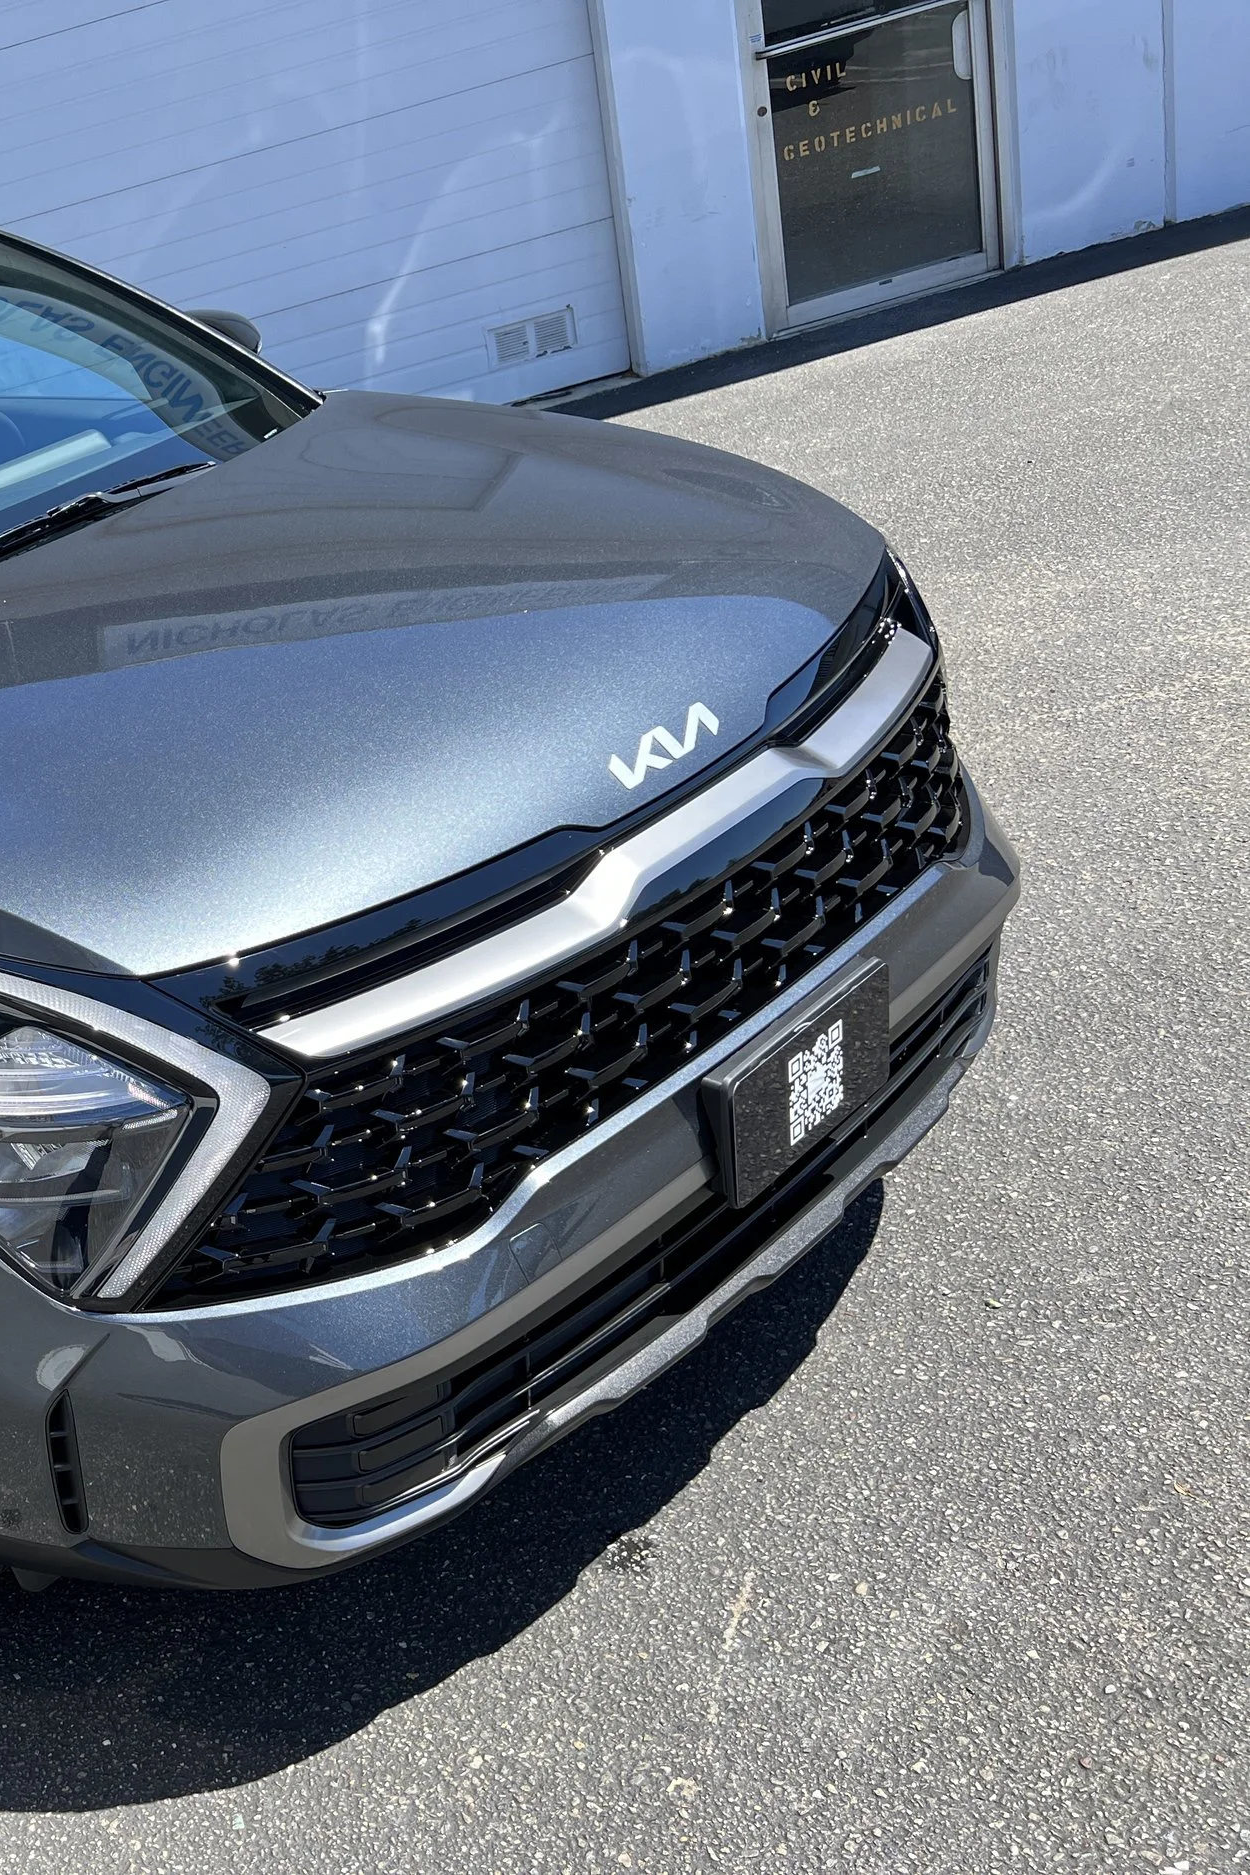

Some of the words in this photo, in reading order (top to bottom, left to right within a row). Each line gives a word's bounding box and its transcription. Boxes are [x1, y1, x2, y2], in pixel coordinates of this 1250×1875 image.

[785, 62, 847, 92] CIVIL
[783, 98, 957, 161] GEOTECHNICAL
[608, 701, 720, 790] KIA
